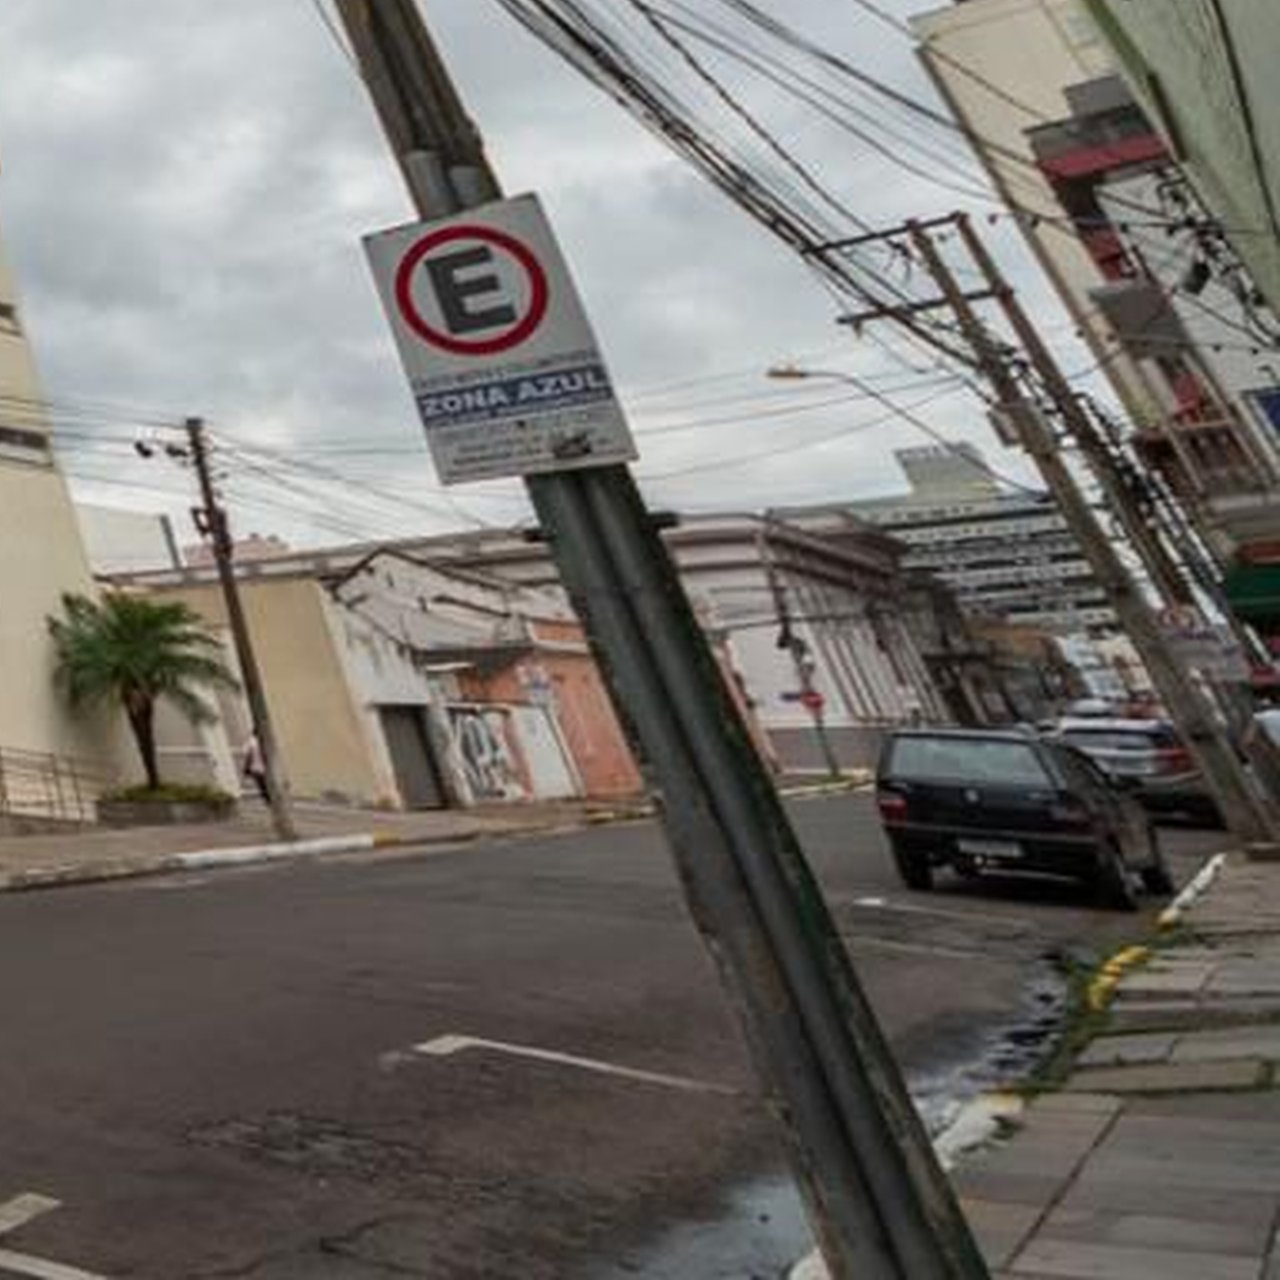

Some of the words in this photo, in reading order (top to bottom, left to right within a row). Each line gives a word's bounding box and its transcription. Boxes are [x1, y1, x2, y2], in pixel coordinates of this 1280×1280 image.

[424, 246, 516, 334] E
[421, 385, 508, 417] ZONA
[517, 371, 603, 401] AZUL
